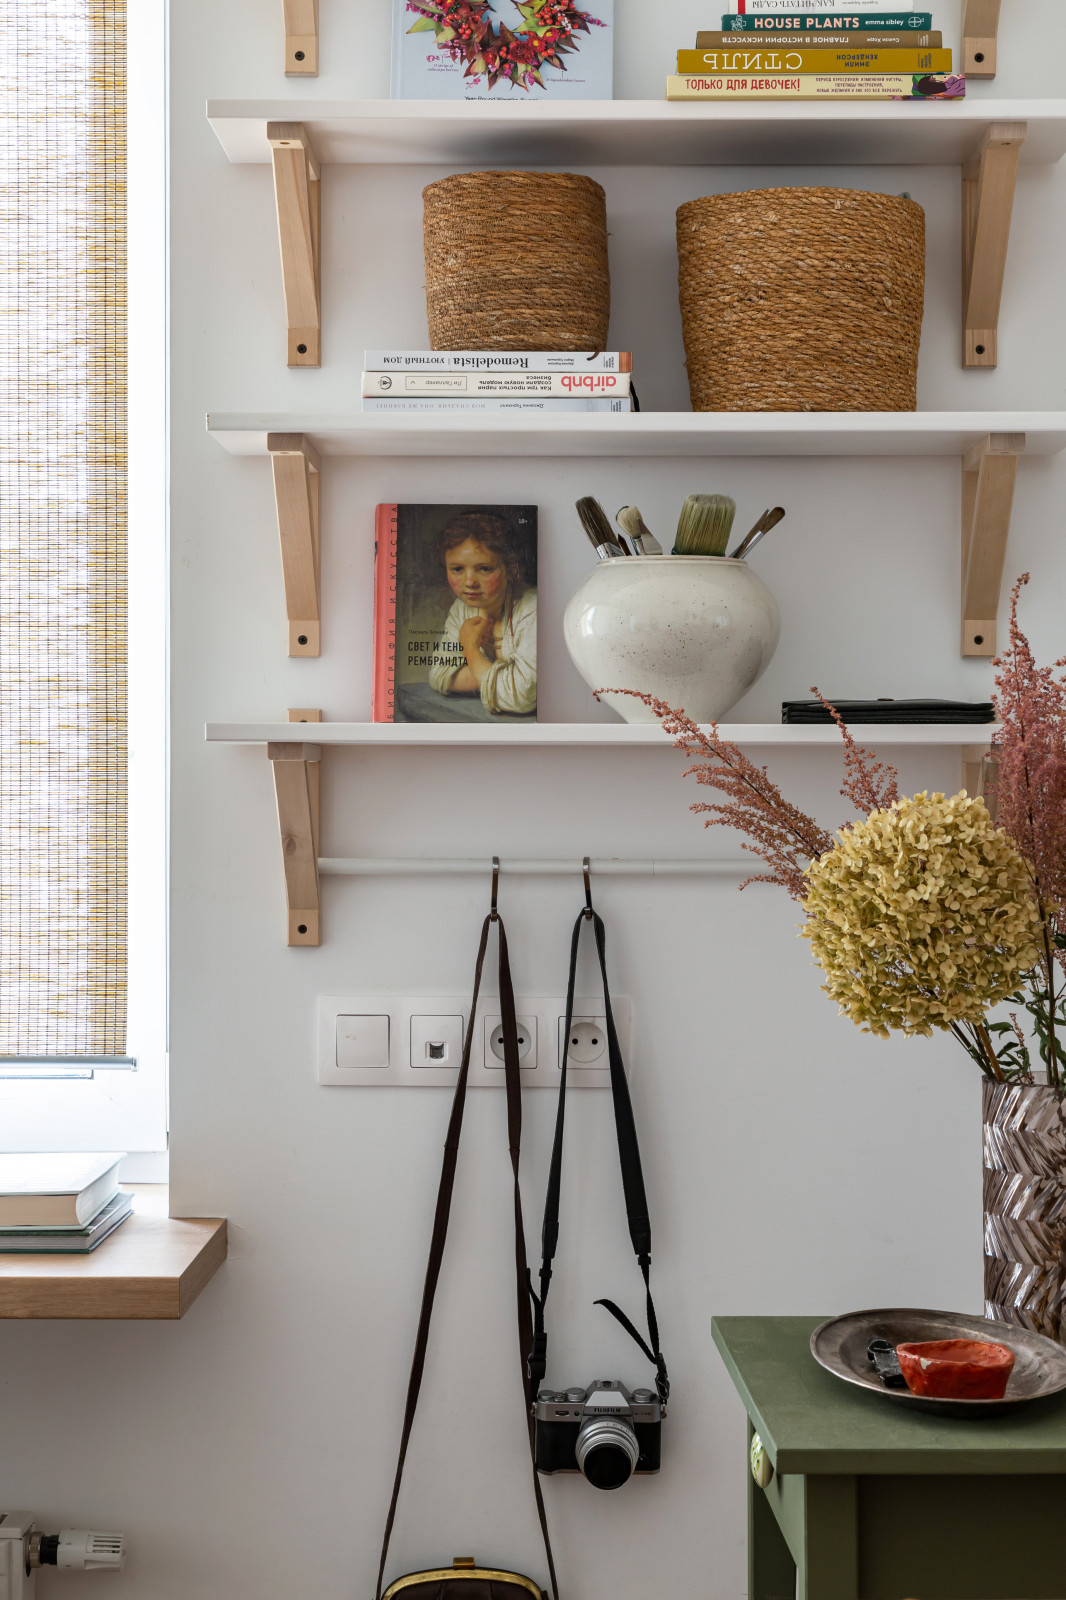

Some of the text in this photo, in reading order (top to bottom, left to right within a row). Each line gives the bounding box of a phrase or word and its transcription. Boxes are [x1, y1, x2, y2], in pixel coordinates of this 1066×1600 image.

[754, 17, 860, 29] HOUSE PLANTS
[886, 18, 904, 26] sibley
[702, 52, 803, 70] СТИЛЬ
[685, 78, 801, 92] ТОЛЬКО ДЛЯ ДЕВОЧЕК!
[452, 358, 529, 368] Remodelista
[560, 376, 616, 392] airbnb
[388, 506, 398, 718] БИОГРАФИЯ ИСКУССТВА
[408, 642, 464, 652] СВЕТ И ТЕНЬ
[408, 656, 468, 667] РЕМБРАНДТА
